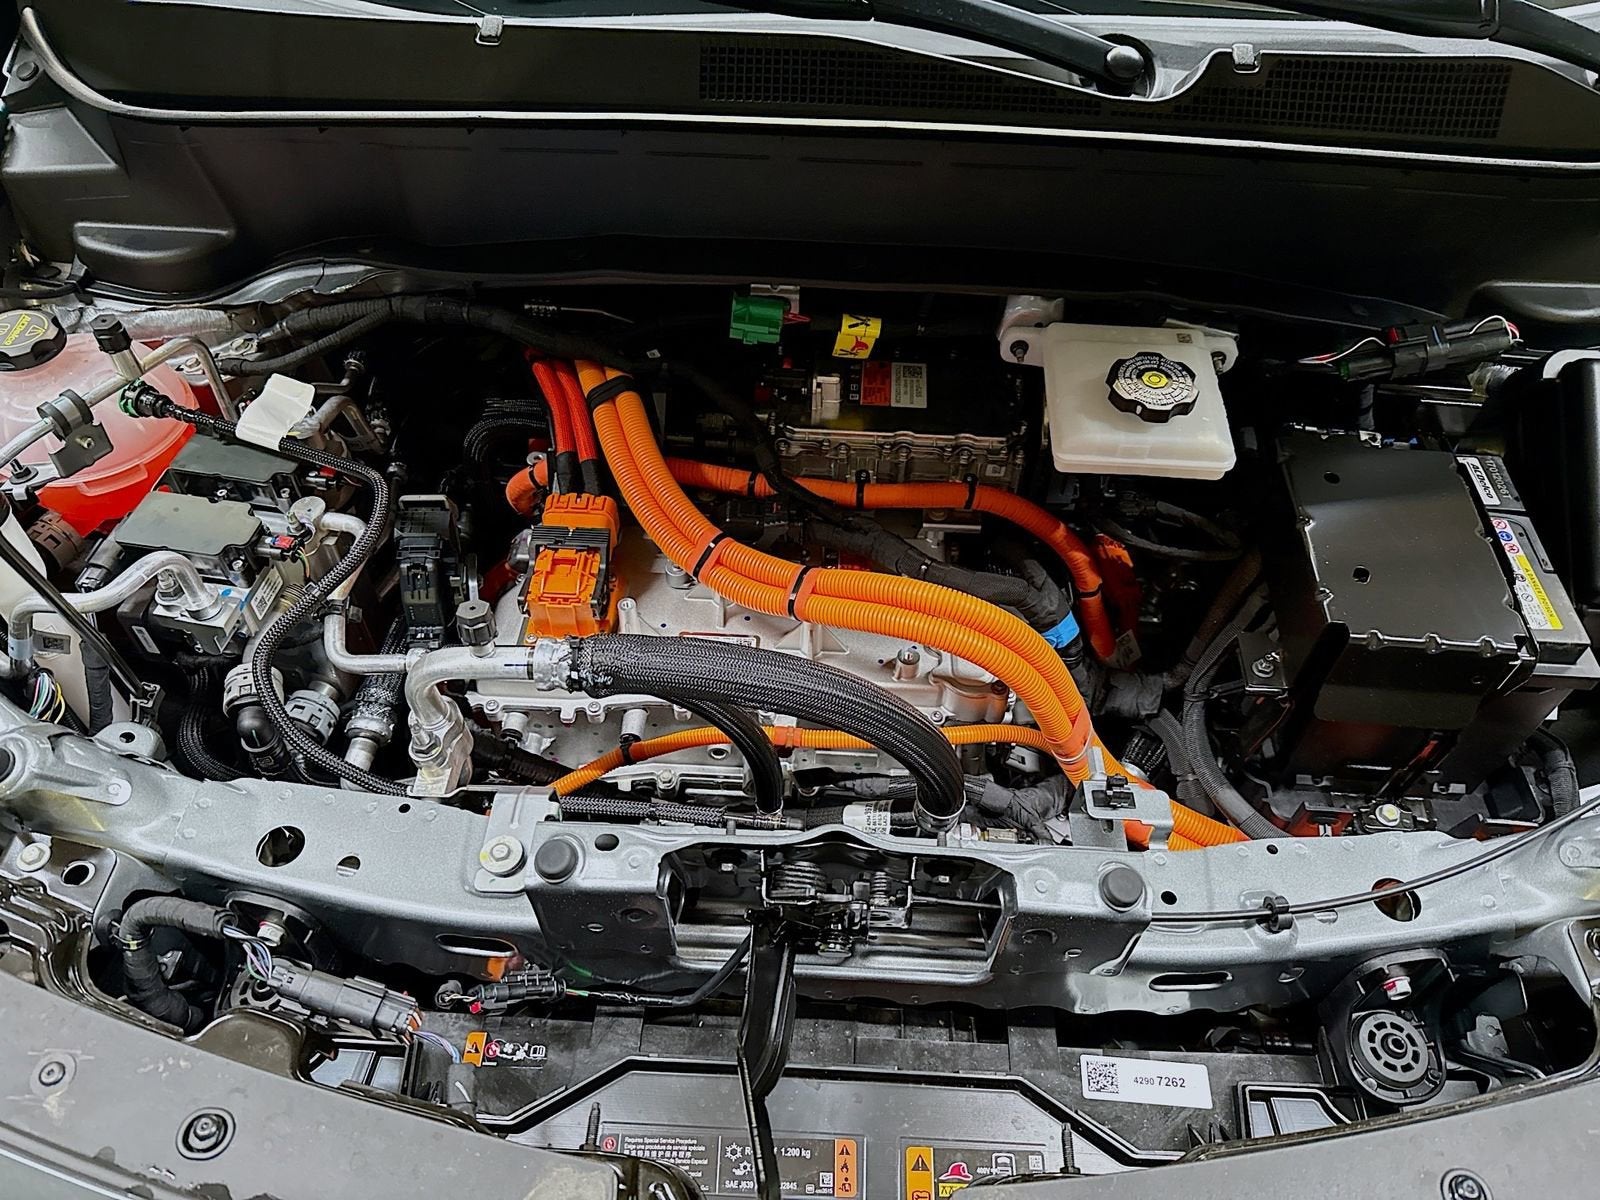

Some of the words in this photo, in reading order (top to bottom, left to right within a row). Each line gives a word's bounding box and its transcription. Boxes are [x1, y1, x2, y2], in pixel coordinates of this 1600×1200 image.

[1470, 462, 1494, 499] ACDelco
[1133, 1076, 1155, 1086] 4290
[1156, 1075, 1186, 1088] 7262
[780, 1147, 800, 1157] 1.200
[801, 1148, 811, 1159] kg
[725, 1180, 739, 1189] SAE
